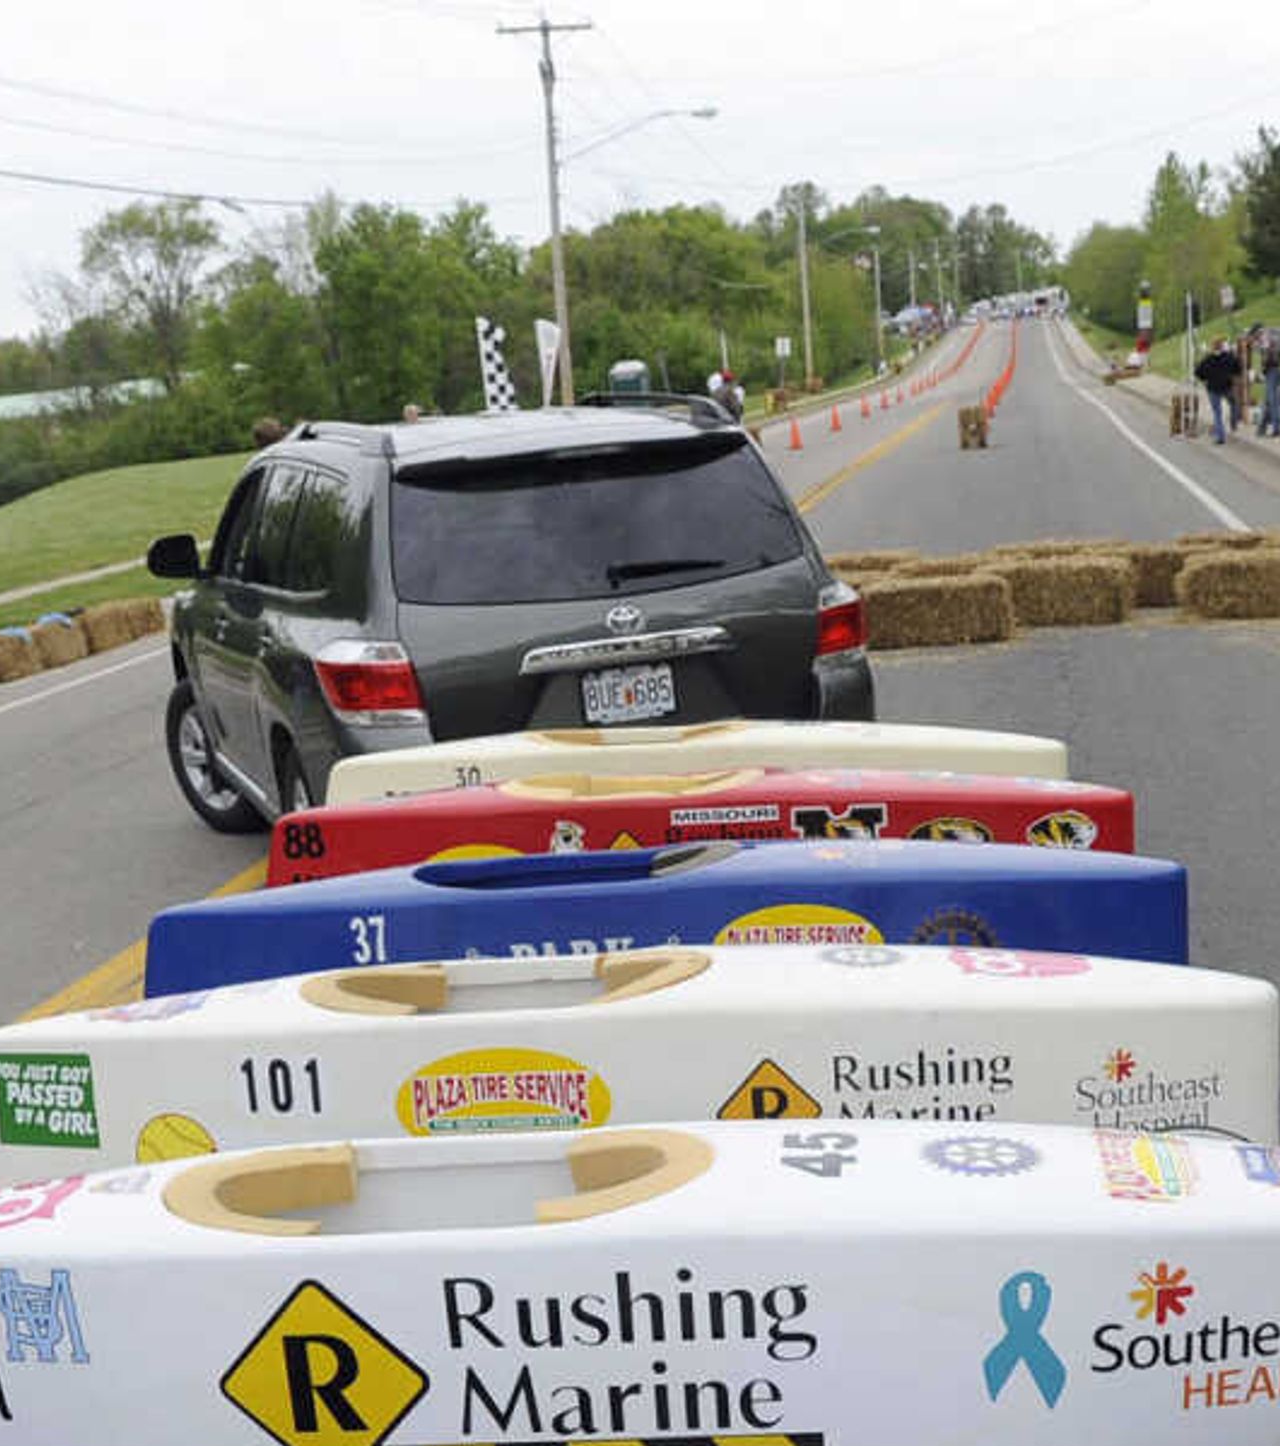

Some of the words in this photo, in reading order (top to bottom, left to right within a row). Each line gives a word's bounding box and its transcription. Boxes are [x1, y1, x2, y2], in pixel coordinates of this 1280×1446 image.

[455, 766, 481, 787] 30
[673, 808, 777, 823] MISSOURI
[283, 823, 325, 859] 88
[350, 915, 386, 964] 37
[60, 1066, 91, 1083] GOT
[241, 1058, 322, 1114] 101
[833, 1047, 1014, 1093] Rushing
[1075, 1070, 1222, 1112] Southeast
[6, 1082, 84, 1108] PASSED
[413, 1077, 468, 1125] PLAZA
[470, 1075, 508, 1101] TIRE
[513, 1073, 589, 1121] SERVICE
[34, 1109, 46, 1126] A
[48, 1110, 97, 1136] GIRL
[780, 1132, 859, 1177] 45
[441, 1268, 818, 1362] Rushing
[281, 1333, 370, 1434] R
[462, 1360, 785, 1436] Marine
